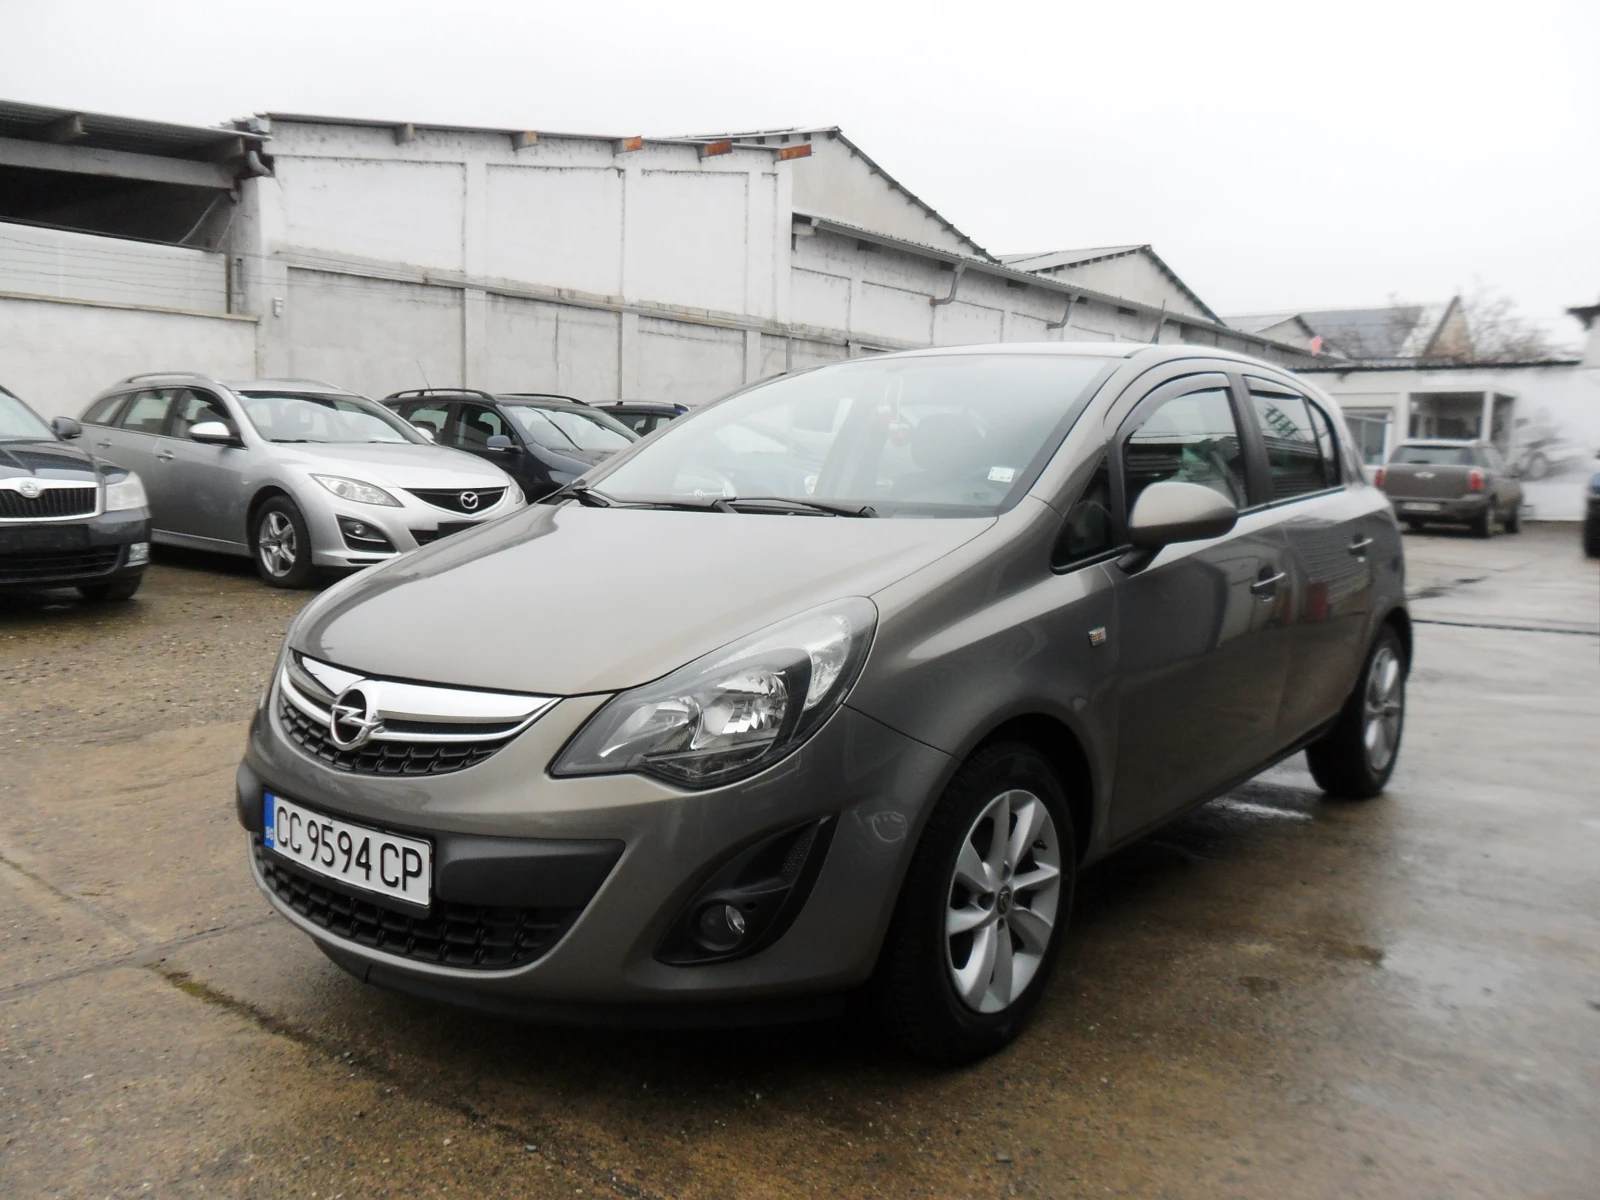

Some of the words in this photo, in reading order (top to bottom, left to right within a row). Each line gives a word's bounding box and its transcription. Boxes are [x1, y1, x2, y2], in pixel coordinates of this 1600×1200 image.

[276, 806, 302, 854] CC
[307, 820, 372, 881] 9594
[379, 842, 423, 891] CP
